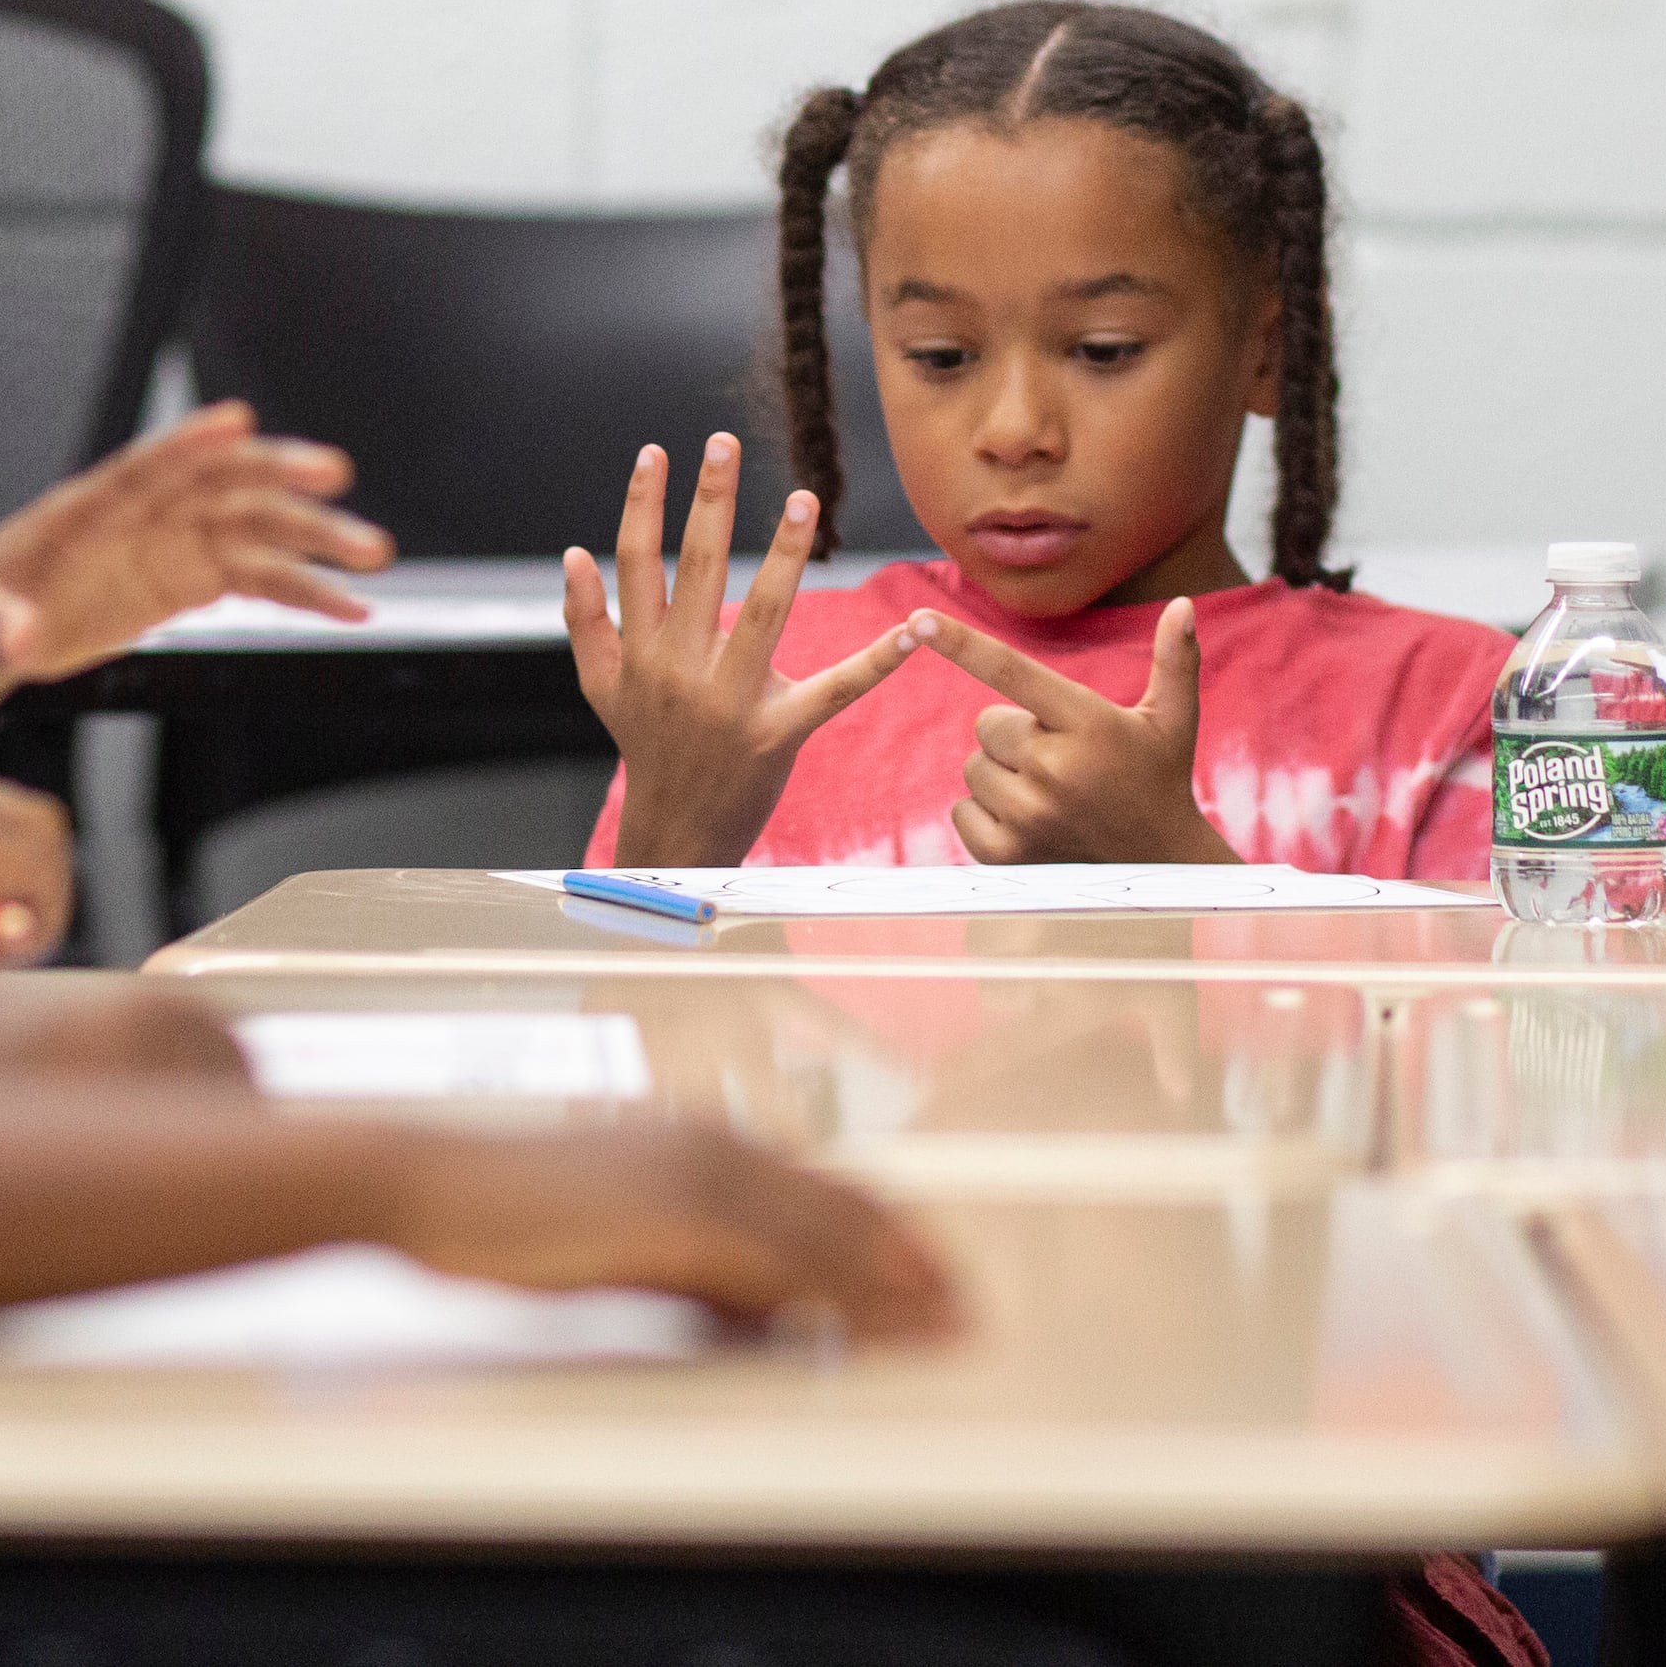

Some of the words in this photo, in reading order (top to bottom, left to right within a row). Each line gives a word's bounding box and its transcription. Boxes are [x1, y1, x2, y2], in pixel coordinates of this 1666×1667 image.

[1508, 744, 1606, 796] Poland
[1510, 780, 1610, 830] Spring
[1553, 812, 1580, 827] 1845
